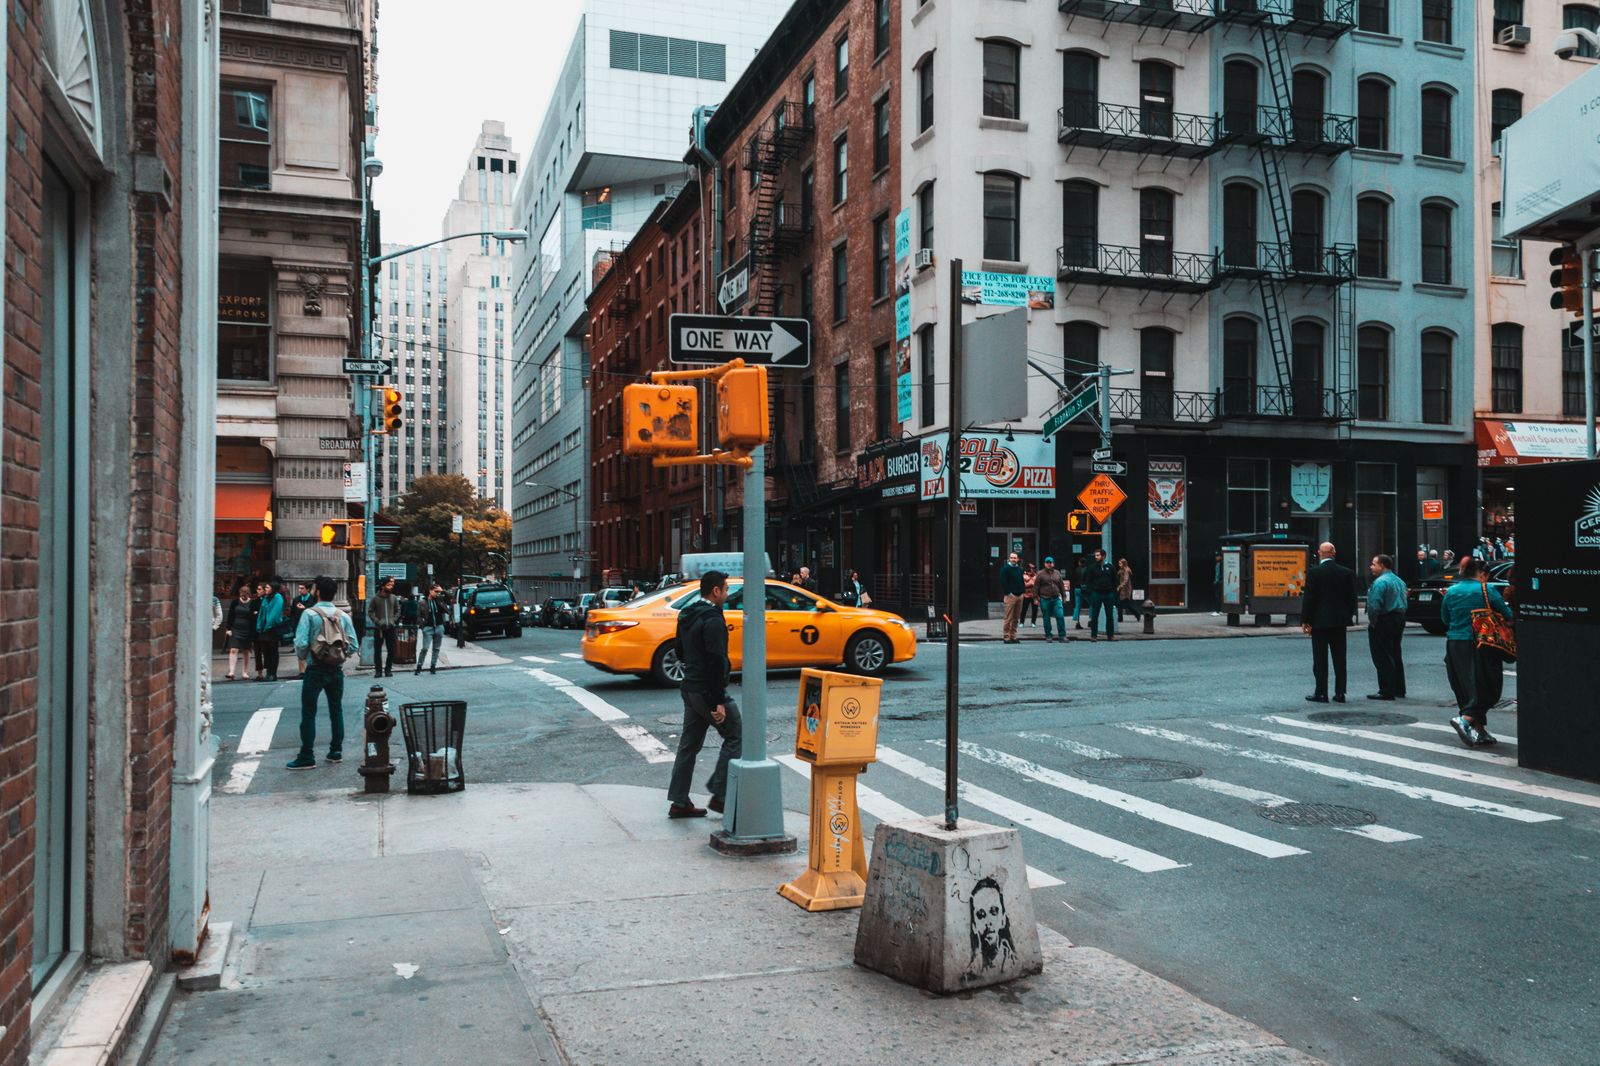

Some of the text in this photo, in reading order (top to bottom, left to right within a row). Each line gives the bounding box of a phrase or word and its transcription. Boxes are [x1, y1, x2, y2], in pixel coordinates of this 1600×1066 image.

[219, 295, 261, 305] EXPORT
[686, 330, 773, 350] ONE WAY
[1054, 399, 1083, 427] Franklin St
[1540, 426, 1578, 434] Properties
[320, 439, 360, 450] BROADWAY
[1537, 434, 1562, 445] Space
[1564, 436, 1578, 444] for
[887, 452, 919, 478] BURGER
[924, 456, 928, 468] 2
[960, 452, 1004, 475] 2 GO
[1504, 457, 1519, 465] 358
[1023, 469, 1053, 487] PIZZA
[1089, 488, 1114, 496] TRAFFIC
[1093, 497, 1109, 505] KEEP
[1534, 567, 1560, 575] General
[805, 629, 815, 642] T
